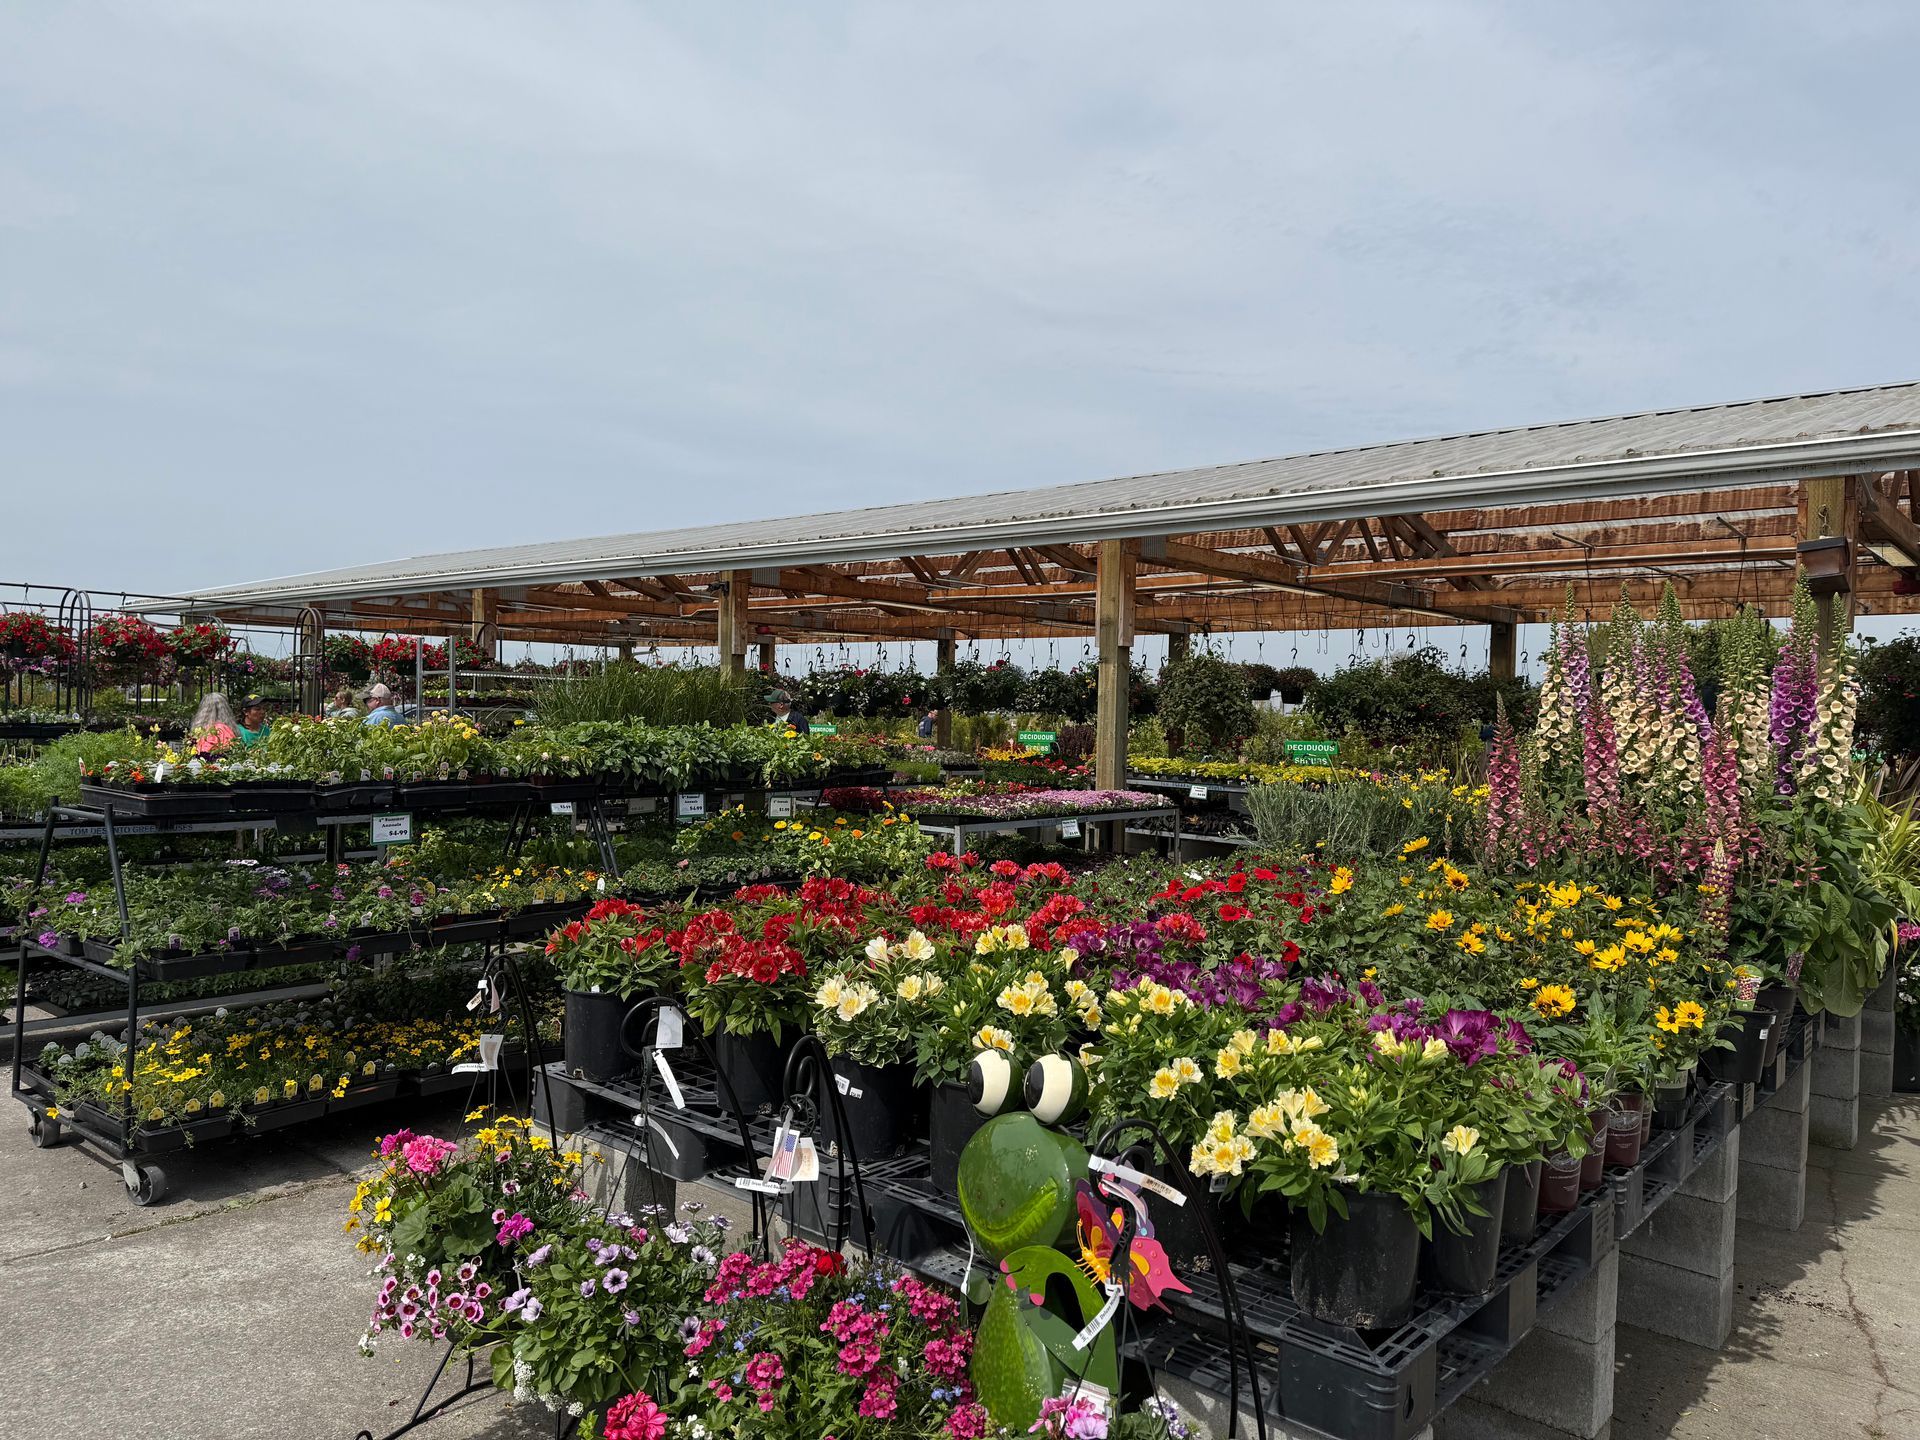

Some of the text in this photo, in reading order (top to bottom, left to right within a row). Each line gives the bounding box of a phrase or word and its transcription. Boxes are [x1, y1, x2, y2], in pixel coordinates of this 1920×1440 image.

[1019, 733, 1054, 741] DECIDUOUS
[1287, 744, 1335, 752] DECIDUOUS
[70, 828, 88, 836] TOM
[90, 826, 131, 836] DESNTO
